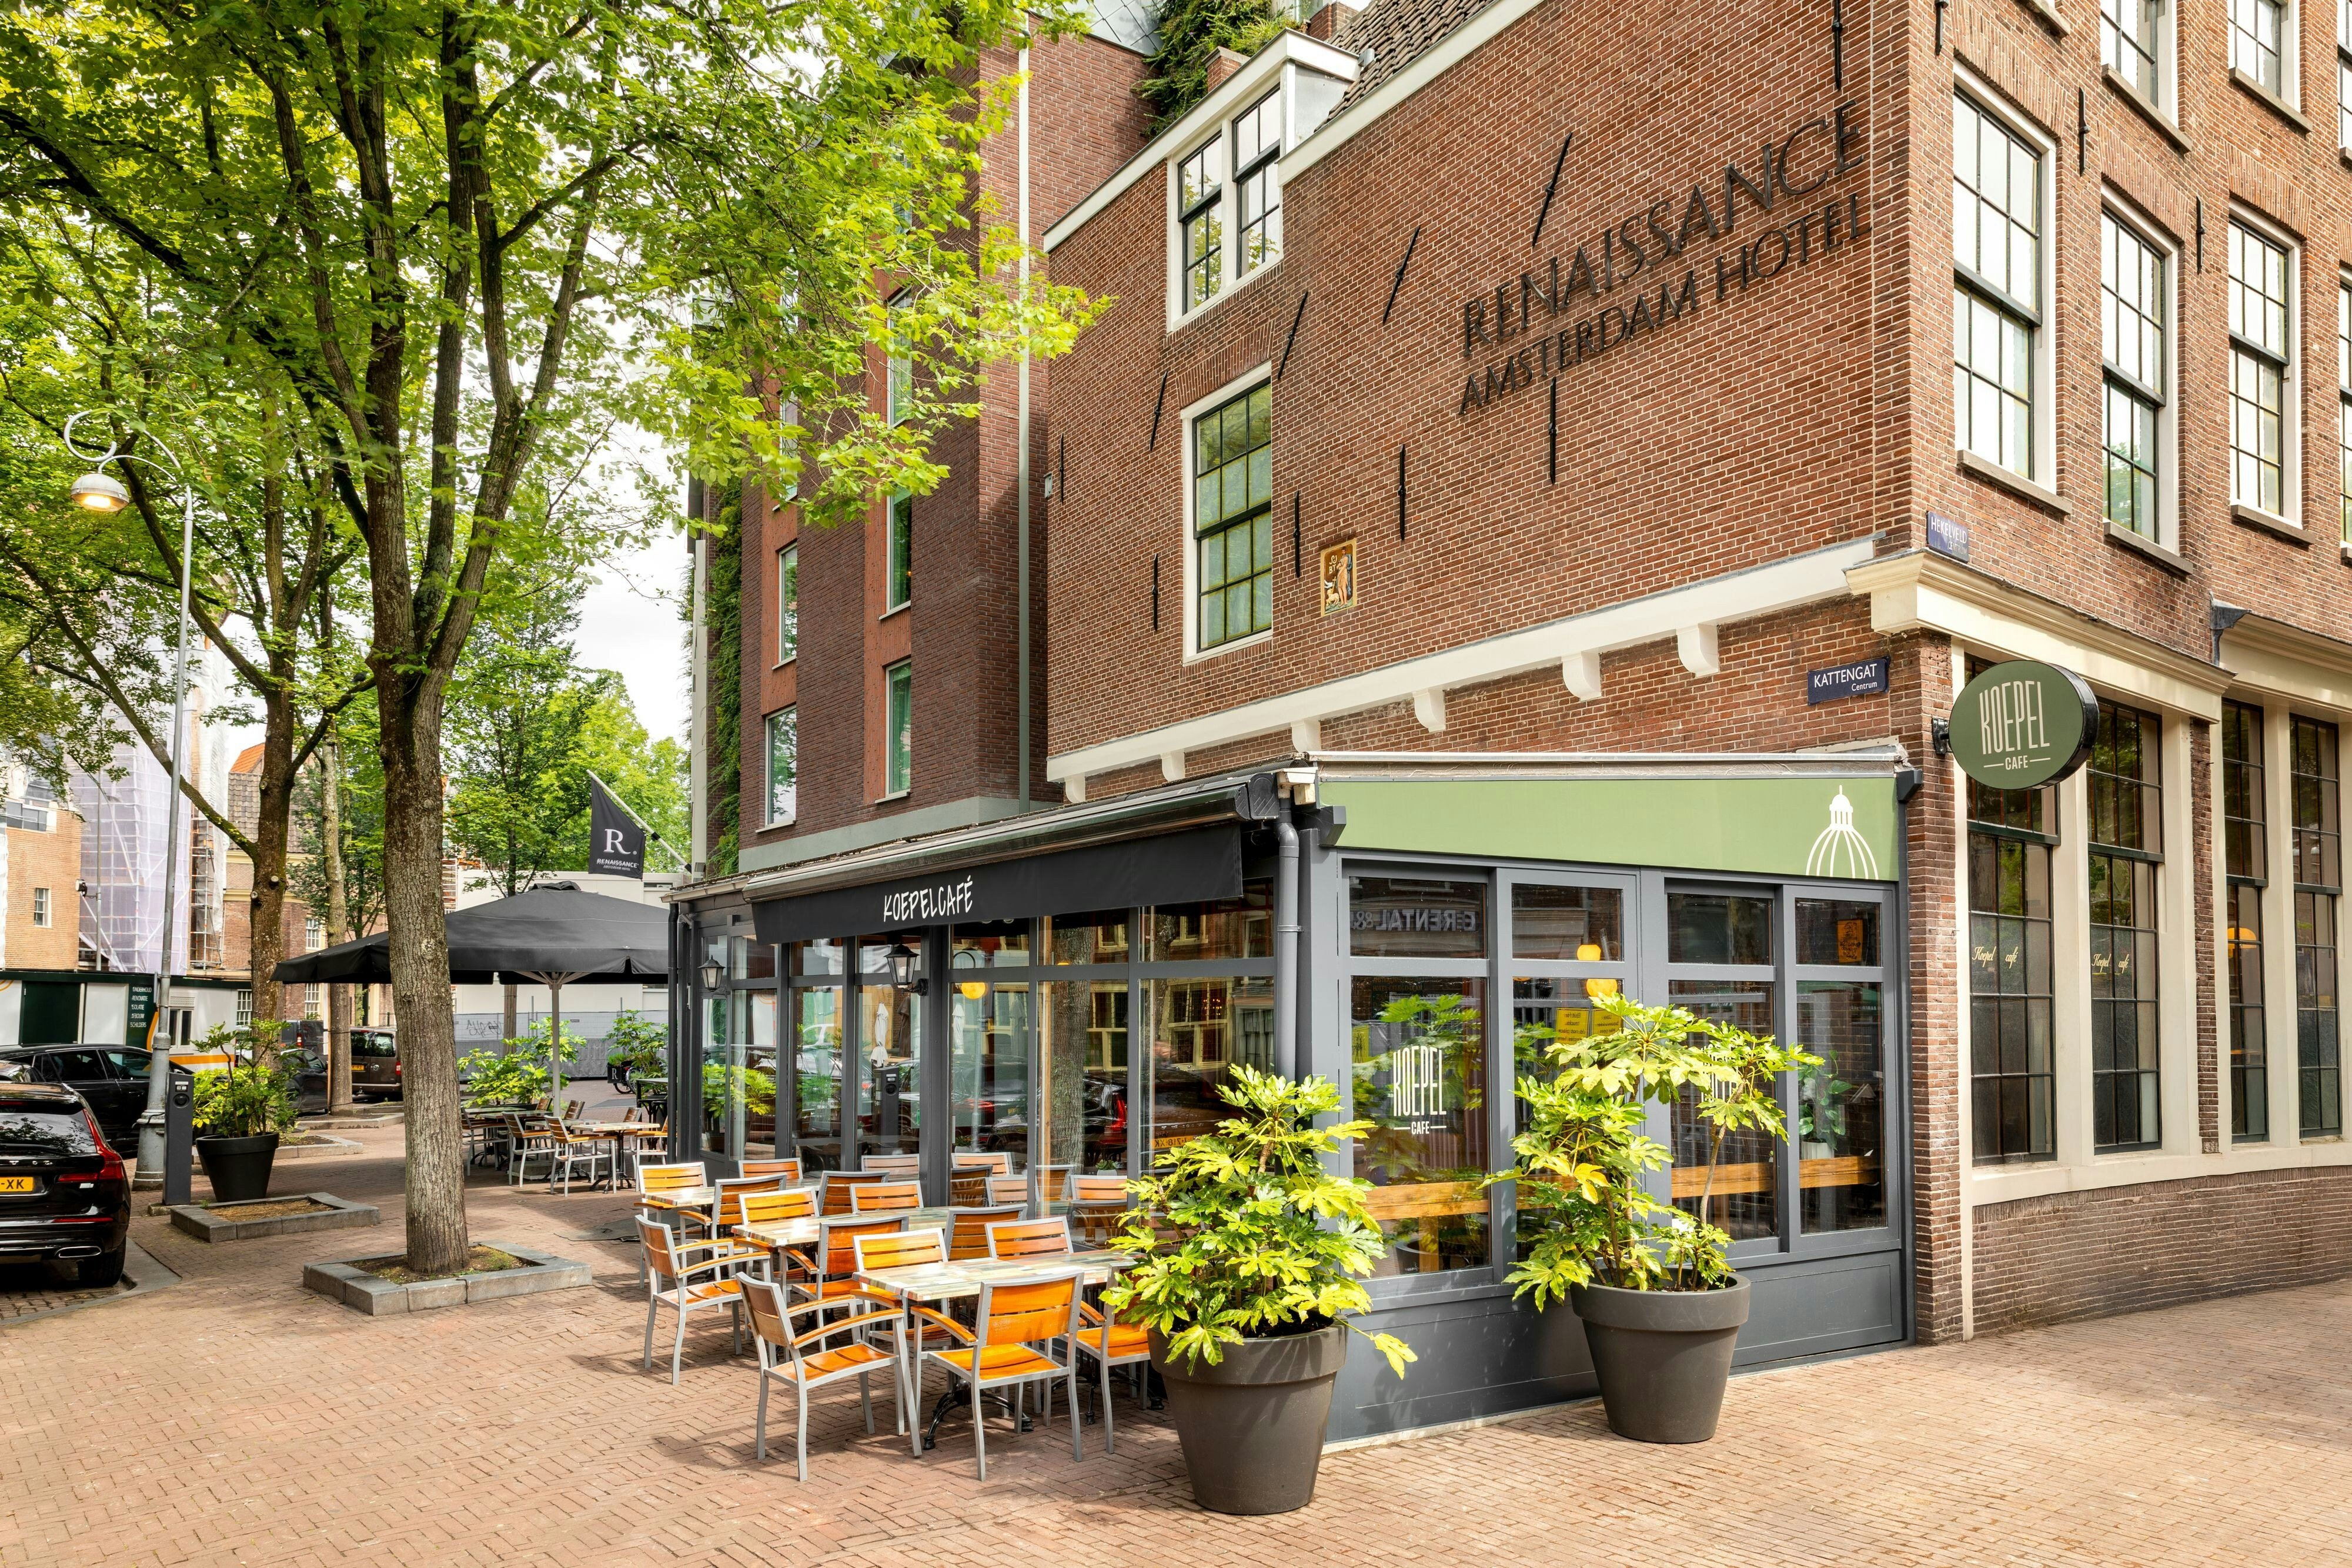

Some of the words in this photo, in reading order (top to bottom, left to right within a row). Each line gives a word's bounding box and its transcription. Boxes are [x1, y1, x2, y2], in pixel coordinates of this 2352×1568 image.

[1463, 99, 1864, 357] RENAISSANCE
[1459, 270, 1697, 415] AMSTERDAM
[1714, 193, 1873, 299] HOTEL
[1931, 516, 1967, 544] HEKELVELD
[1814, 663, 1877, 688] KATTENGAT
[1851, 681, 1877, 691] Centrum
[1979, 680, 2050, 755] KOEPEL
[2005, 755, 2029, 770] CAFE
[1972, 945, 1997, 968] Koepel
[2005, 946, 2019, 969] café
[2091, 953, 2112, 973] Koepel
[2118, 954, 2130, 974] café
[612, 1068, 619, 1079] R
[1393, 1045, 1446, 1116] KOEPEL
[1411, 1121, 1430, 1135] CAFE
